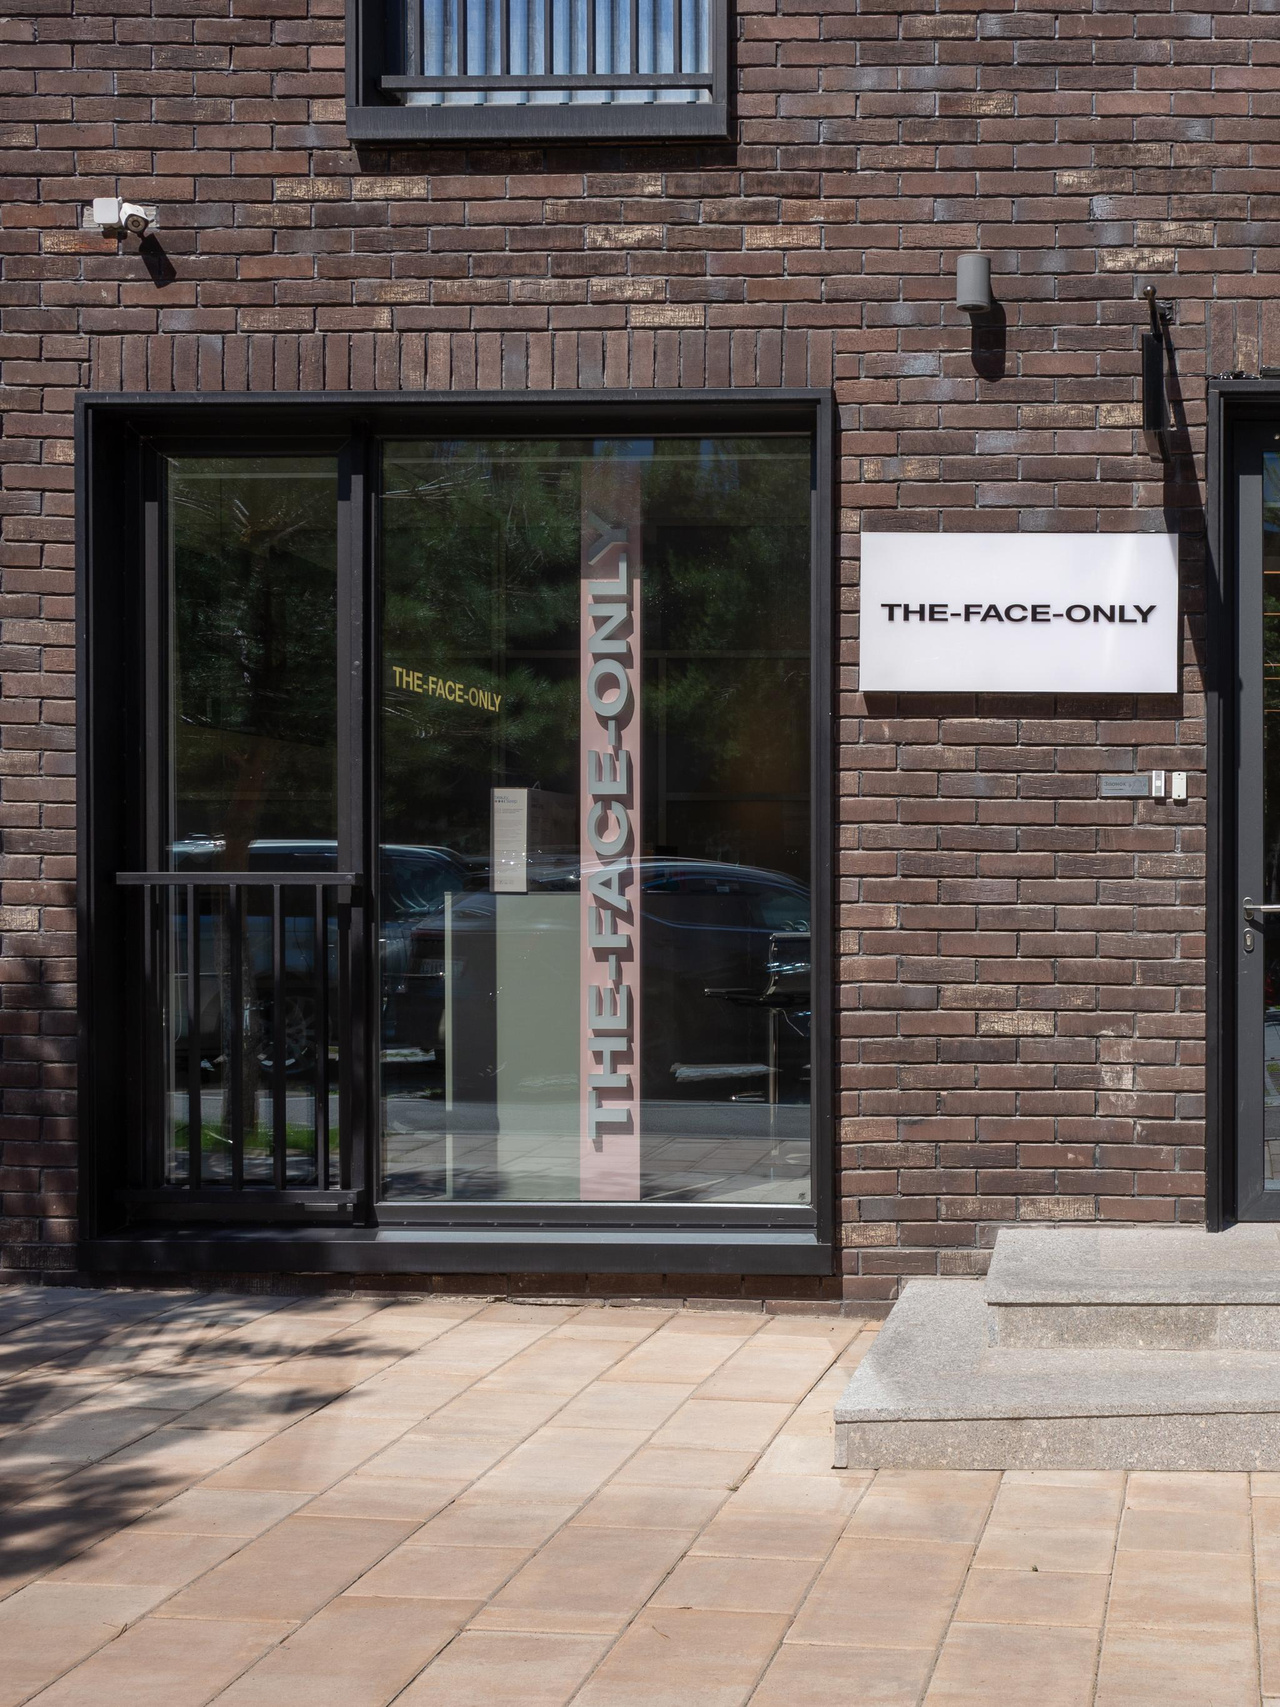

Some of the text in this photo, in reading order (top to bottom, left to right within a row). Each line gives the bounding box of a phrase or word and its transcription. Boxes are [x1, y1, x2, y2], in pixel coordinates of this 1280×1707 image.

[881, 603, 1157, 623] THE-FACE-ONLY
[392, 666, 502, 713] THE-FACE-ONLY
[587, 514, 631, 1143] THE-FACE-ONLY
